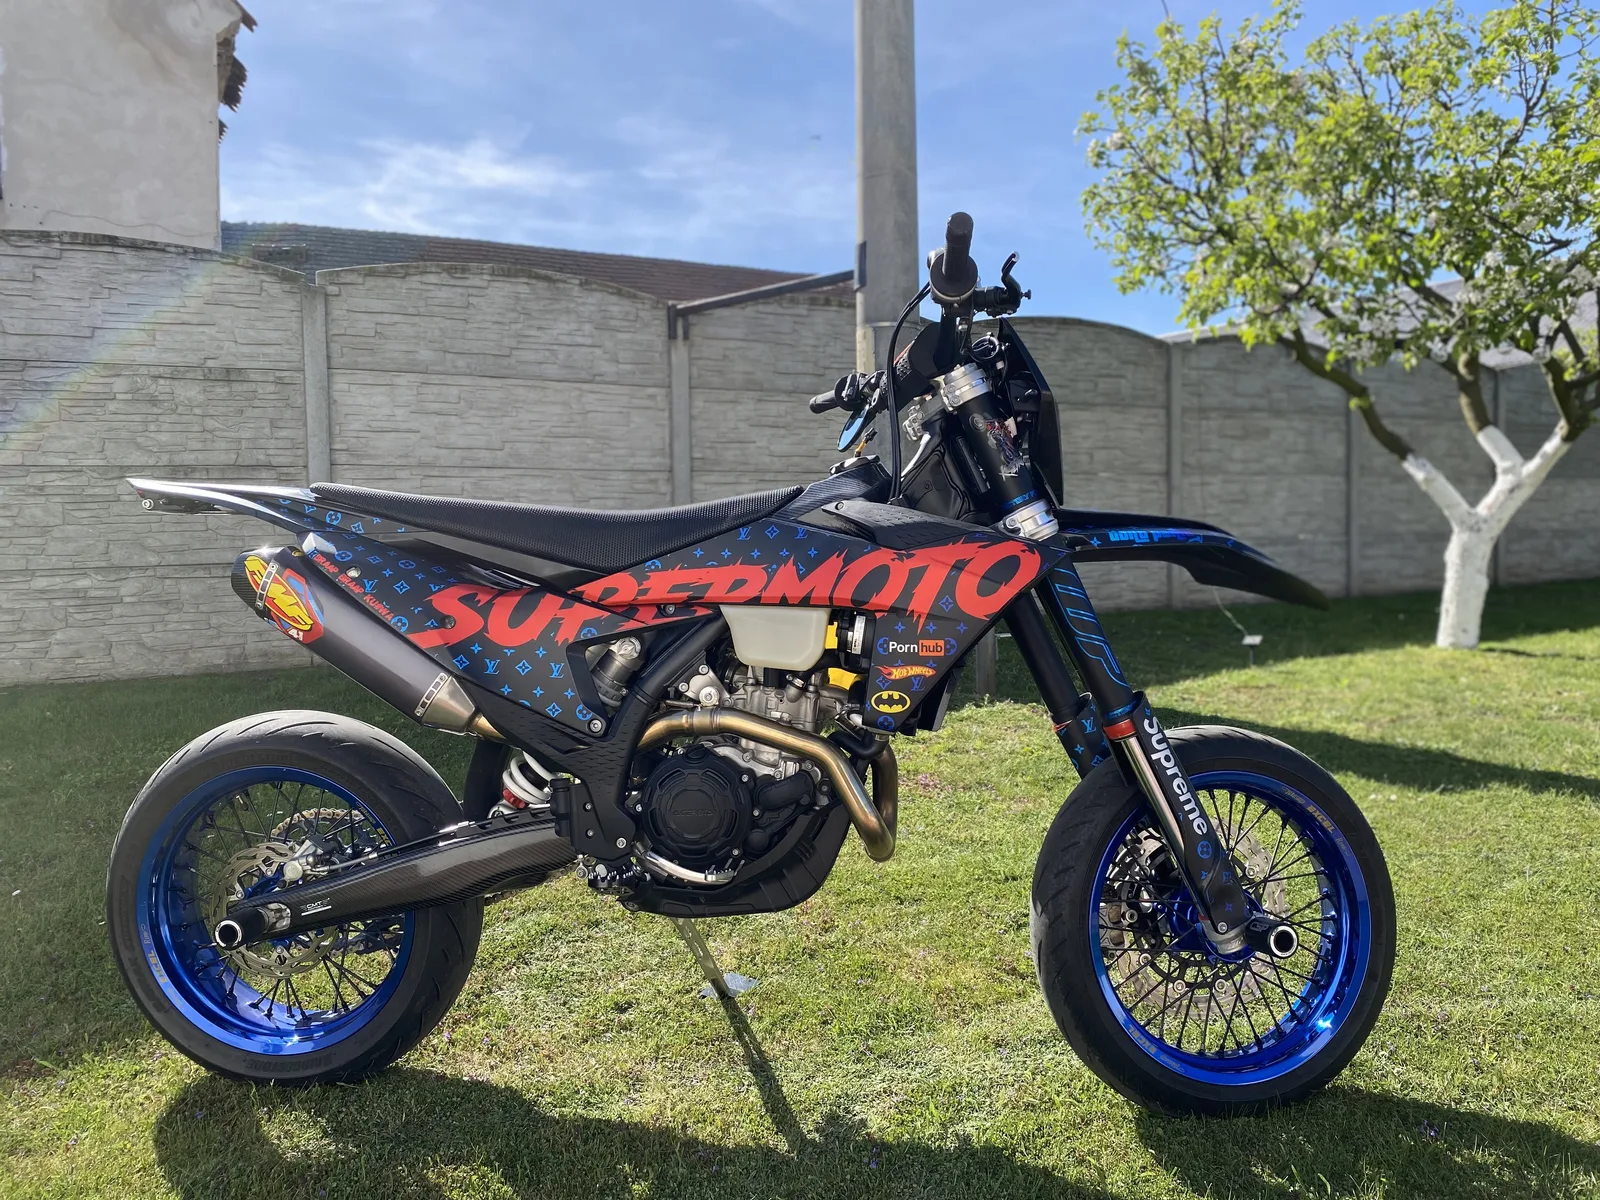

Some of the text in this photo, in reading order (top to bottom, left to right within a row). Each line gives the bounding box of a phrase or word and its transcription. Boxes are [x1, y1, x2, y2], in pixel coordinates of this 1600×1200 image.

[244, 558, 314, 627] FMF
[405, 537, 1042, 648] SUPERMOTO
[1143, 716, 1208, 835] Supreme
